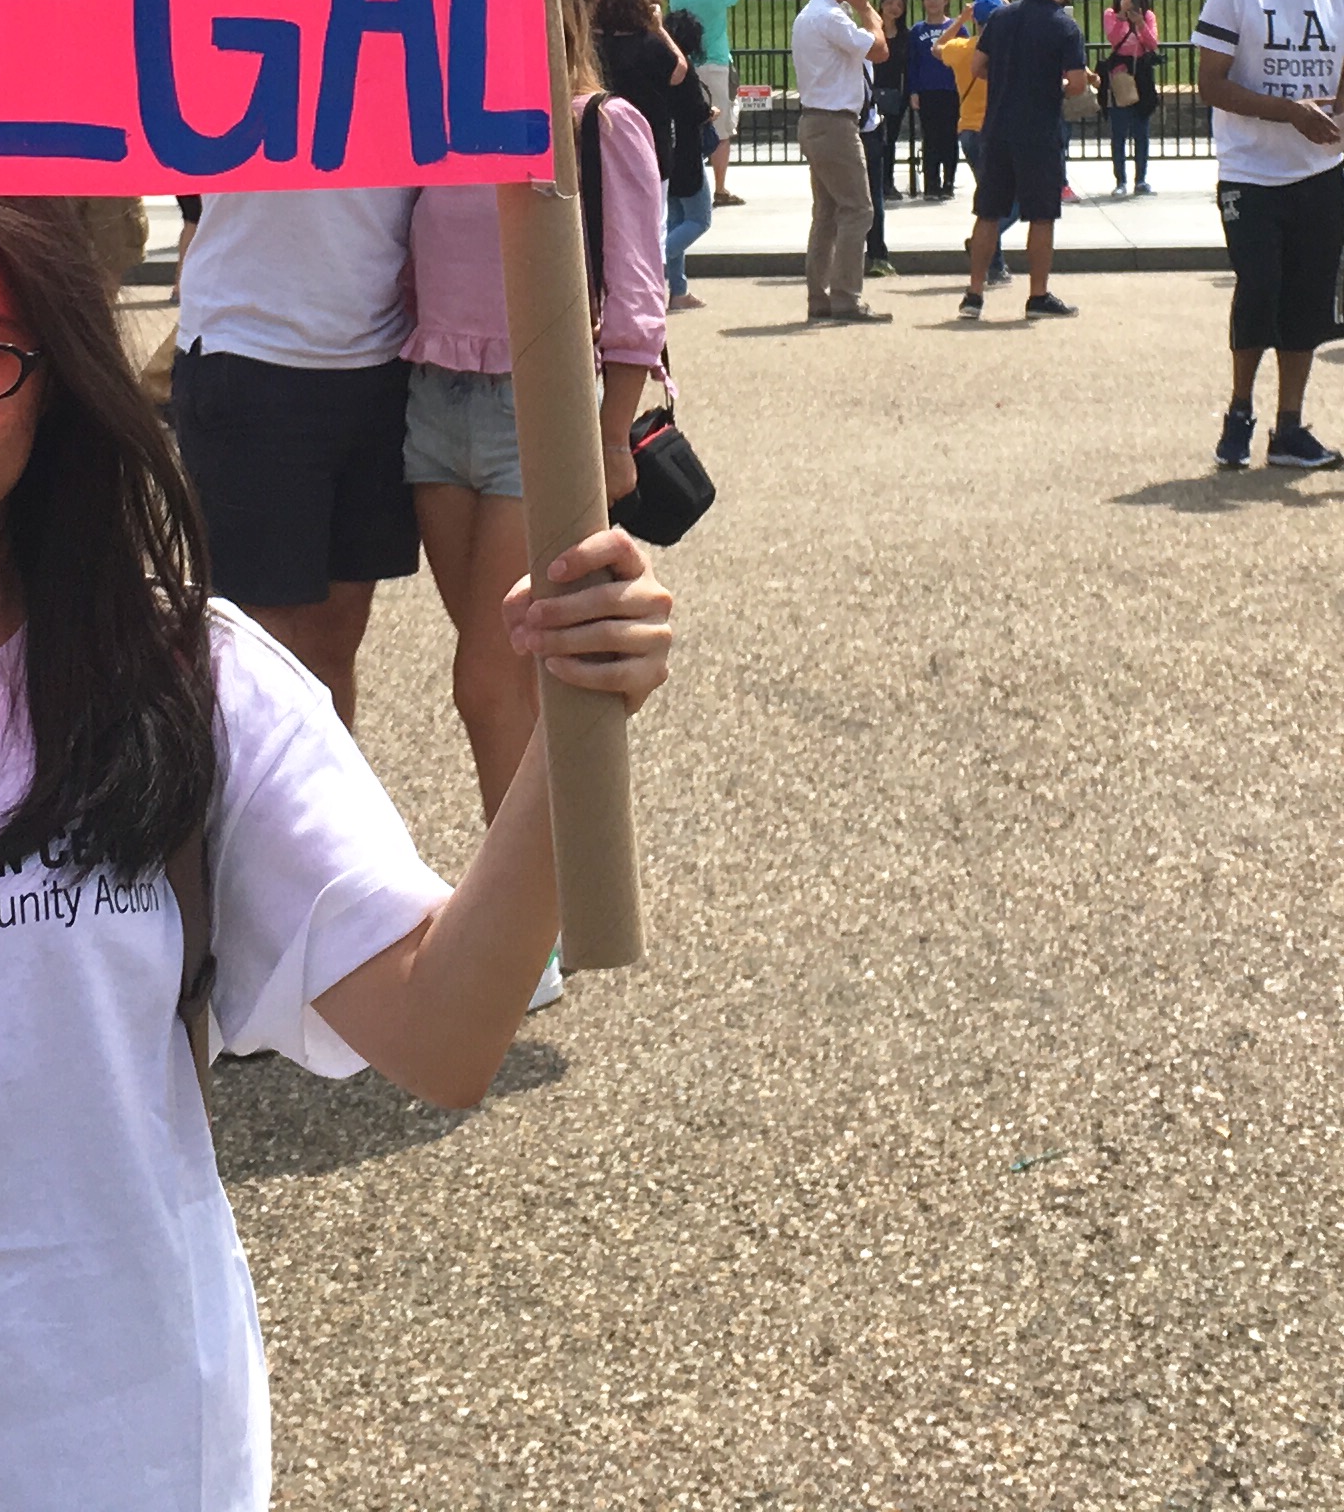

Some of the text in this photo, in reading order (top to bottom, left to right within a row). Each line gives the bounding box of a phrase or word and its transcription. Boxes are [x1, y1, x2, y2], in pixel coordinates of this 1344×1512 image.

[1263, 9, 1337, 52] L.A.
[1263, 58, 1334, 77] SPORTS
[94, 874, 160, 916] Action
